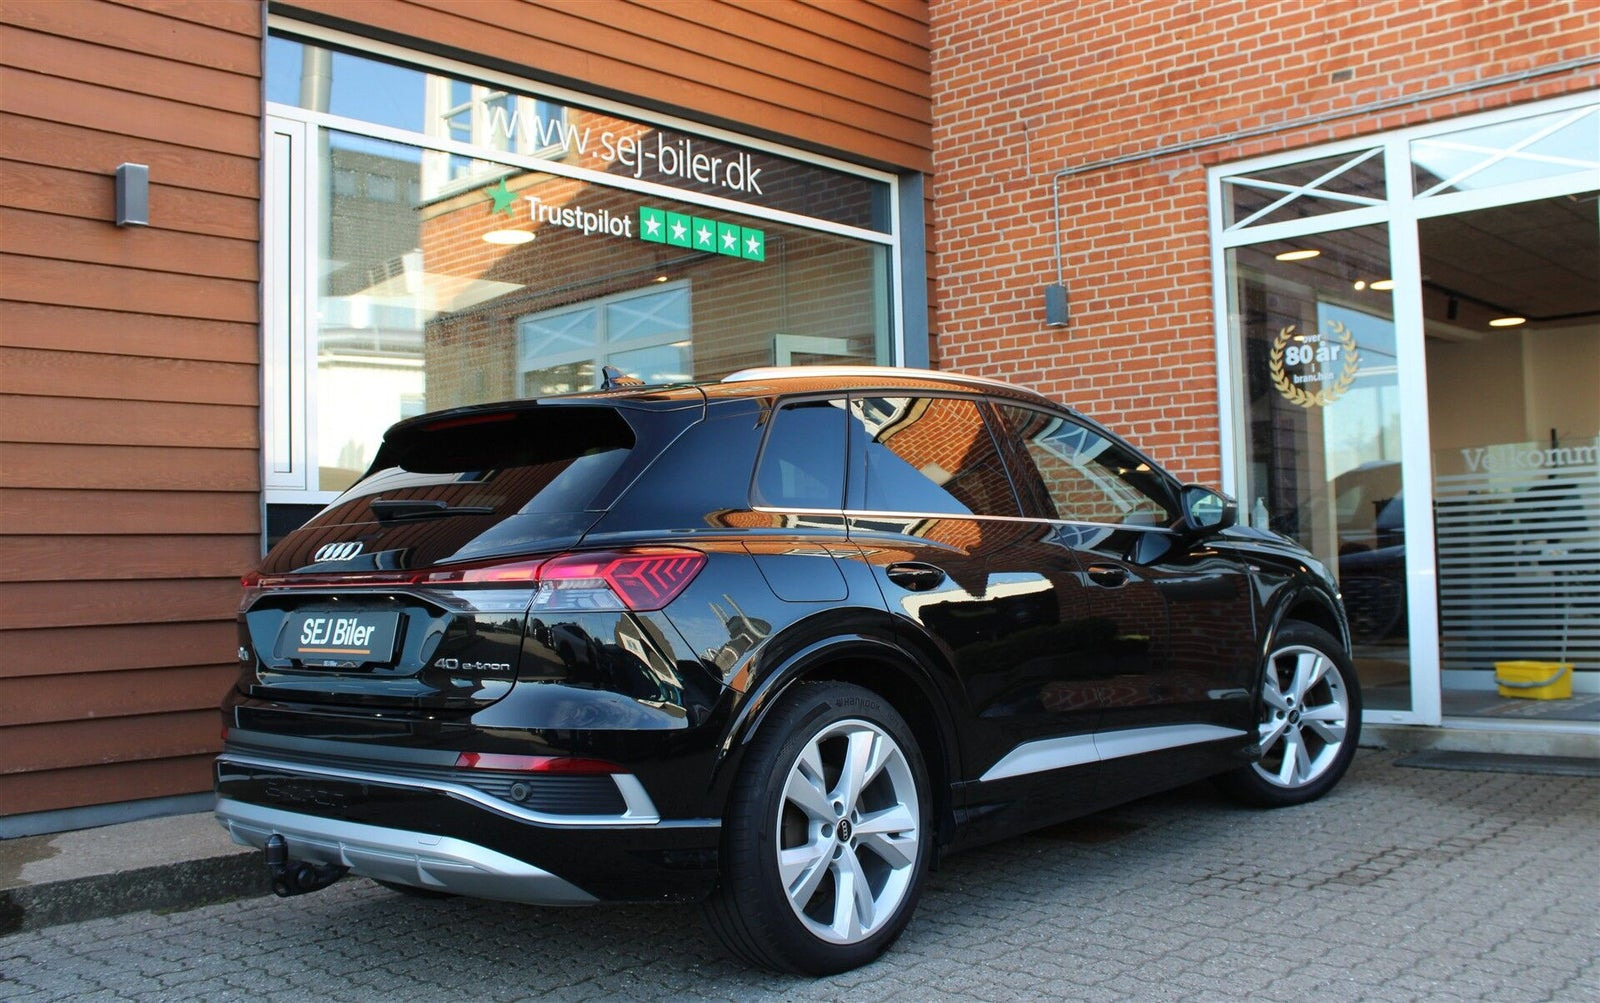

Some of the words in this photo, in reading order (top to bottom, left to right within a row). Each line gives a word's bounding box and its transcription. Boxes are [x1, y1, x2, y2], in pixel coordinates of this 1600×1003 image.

[482, 104, 763, 194] www.sej-biler.dk
[525, 196, 632, 237] Trustpilot
[1285, 345, 1313, 365] 80
[1316, 341, 1340, 362] år
[300, 618, 334, 645] SEJ
[332, 618, 375, 646] Biler
[434, 658, 459, 670] 40
[462, 661, 510, 671] e-tron
